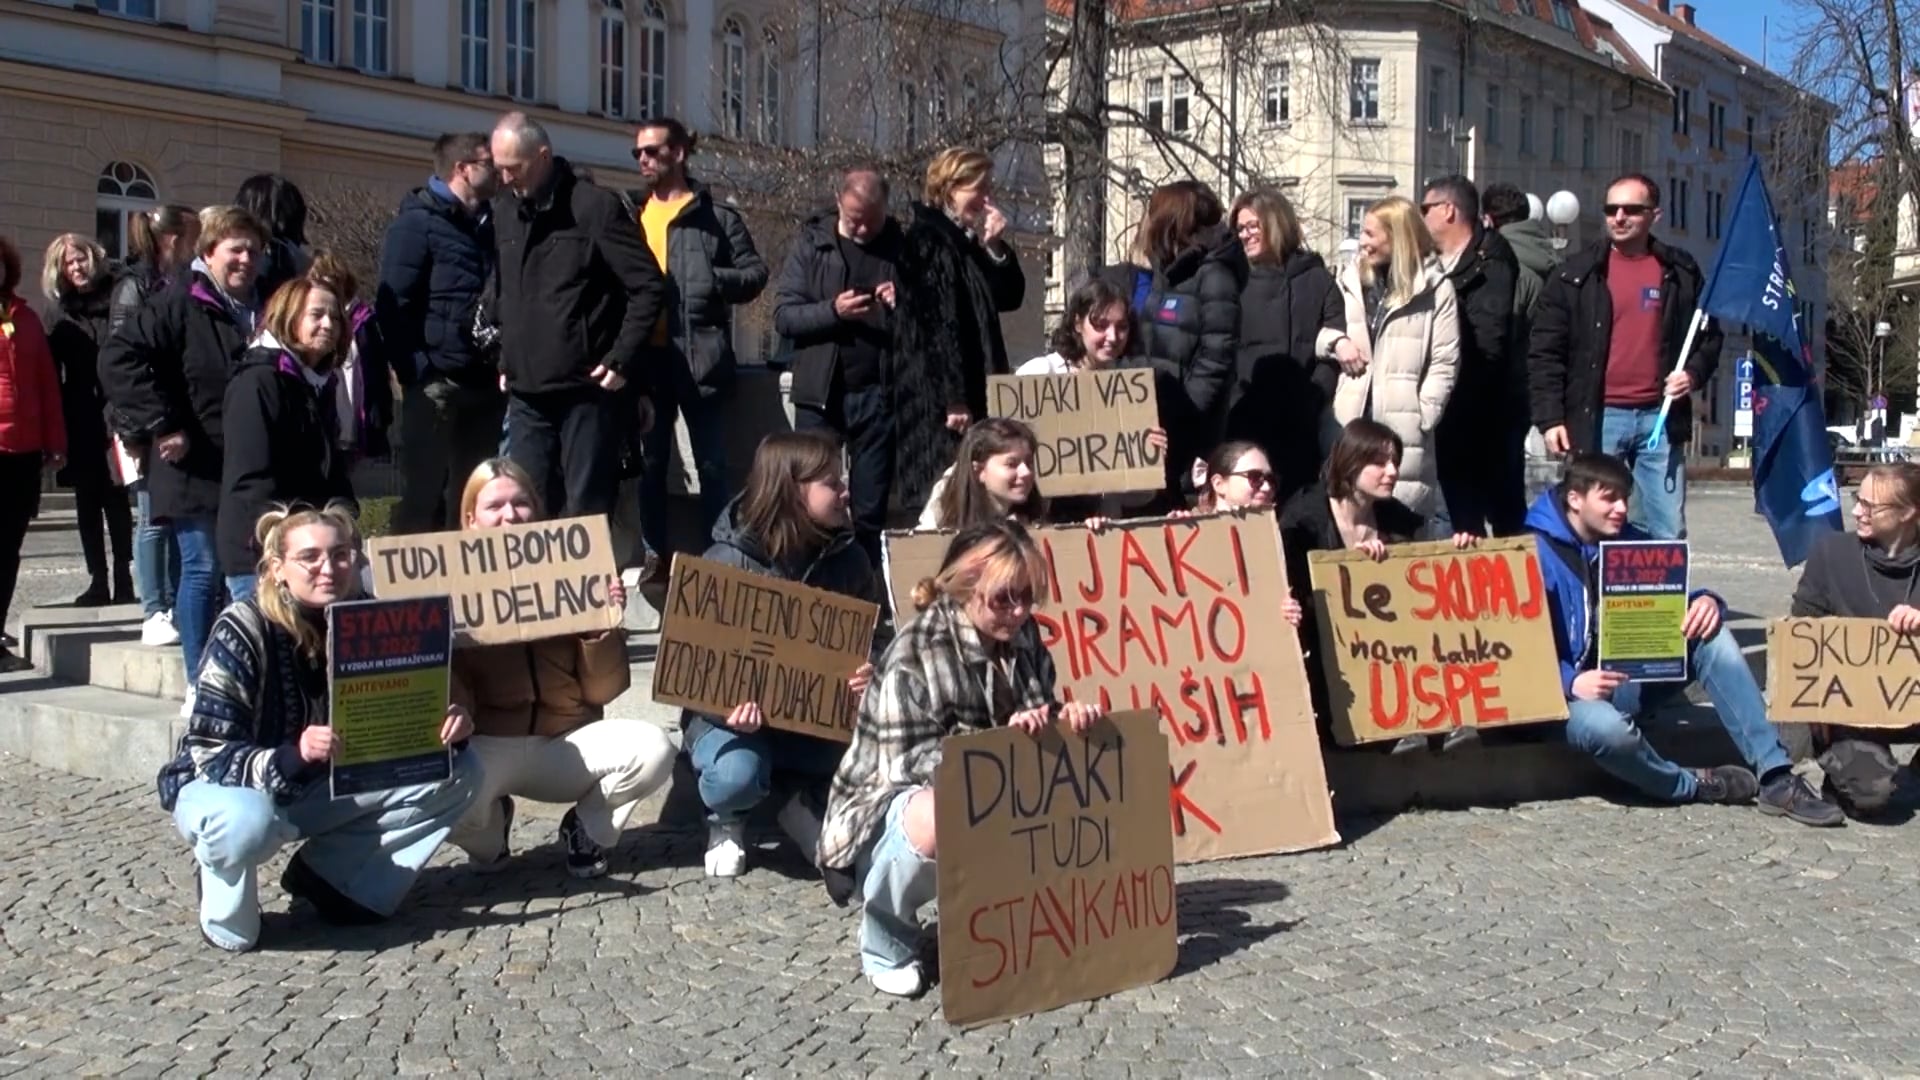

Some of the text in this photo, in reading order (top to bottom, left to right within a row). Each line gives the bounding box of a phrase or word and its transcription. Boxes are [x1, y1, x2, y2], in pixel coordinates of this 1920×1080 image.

[997, 372, 1148, 418] DIJAKI VAS
[1740, 382, 1752, 397] P
[1035, 428, 1160, 478] DPIRAMO
[378, 522, 591, 584] TUDI MI BOMO
[1043, 524, 1250, 604] IJAKI
[1606, 548, 1685, 569] STAVKA
[674, 564, 802, 642] KVALITETNO
[1338, 553, 1544, 623] Le SKUPAJ
[339, 603, 443, 638] STAVKA
[1034, 596, 1247, 681] PIRAMO
[1369, 659, 1508, 730] USPE
[1790, 675, 1853, 708] ZA
[963, 735, 1124, 826] DIJAKI
[1011, 815, 1109, 875] TUDI
[969, 864, 1173, 988] STAVKAMO
